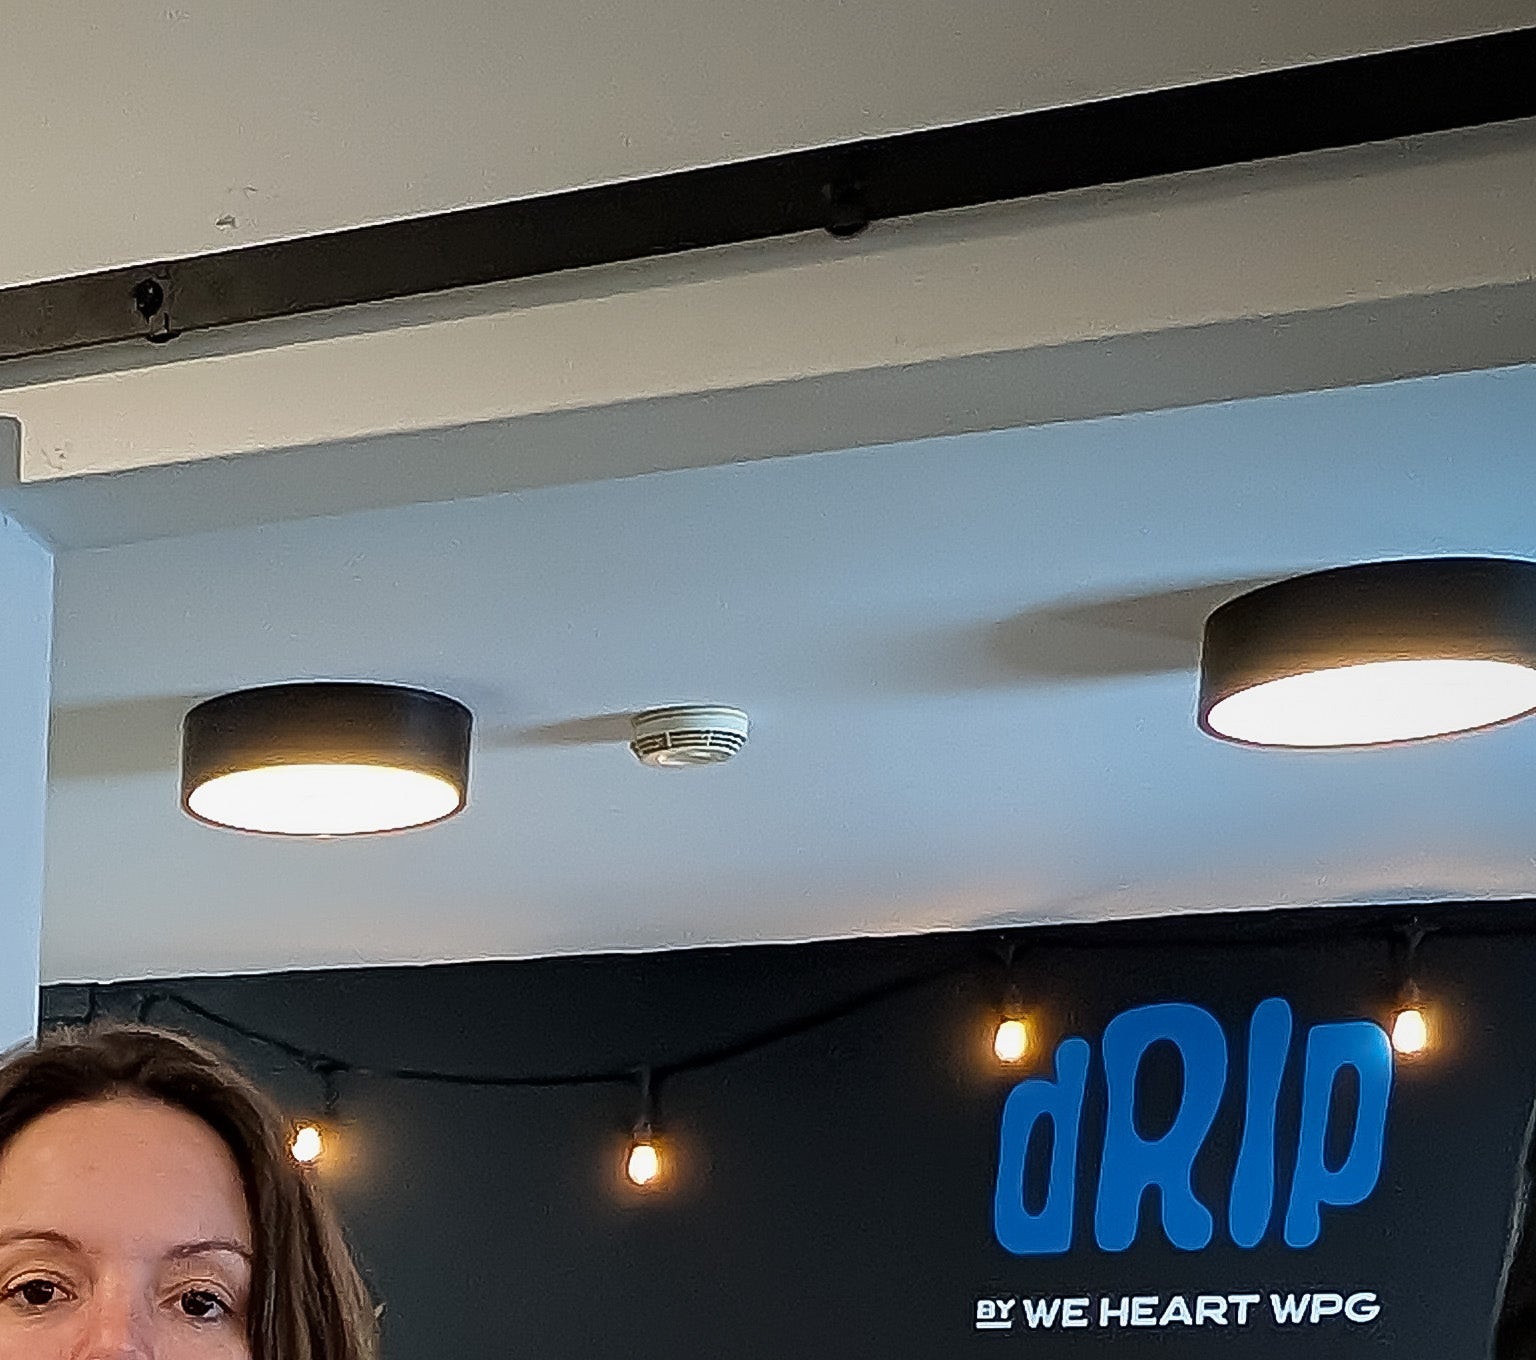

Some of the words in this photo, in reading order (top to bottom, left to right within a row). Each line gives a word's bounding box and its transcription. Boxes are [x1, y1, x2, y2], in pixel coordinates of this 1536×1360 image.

[976, 1299, 1015, 1321] BY
[1023, 1298, 1089, 1328] WE
[1099, 1295, 1260, 1327] HEART
[1269, 1292, 1381, 1325] WPG
